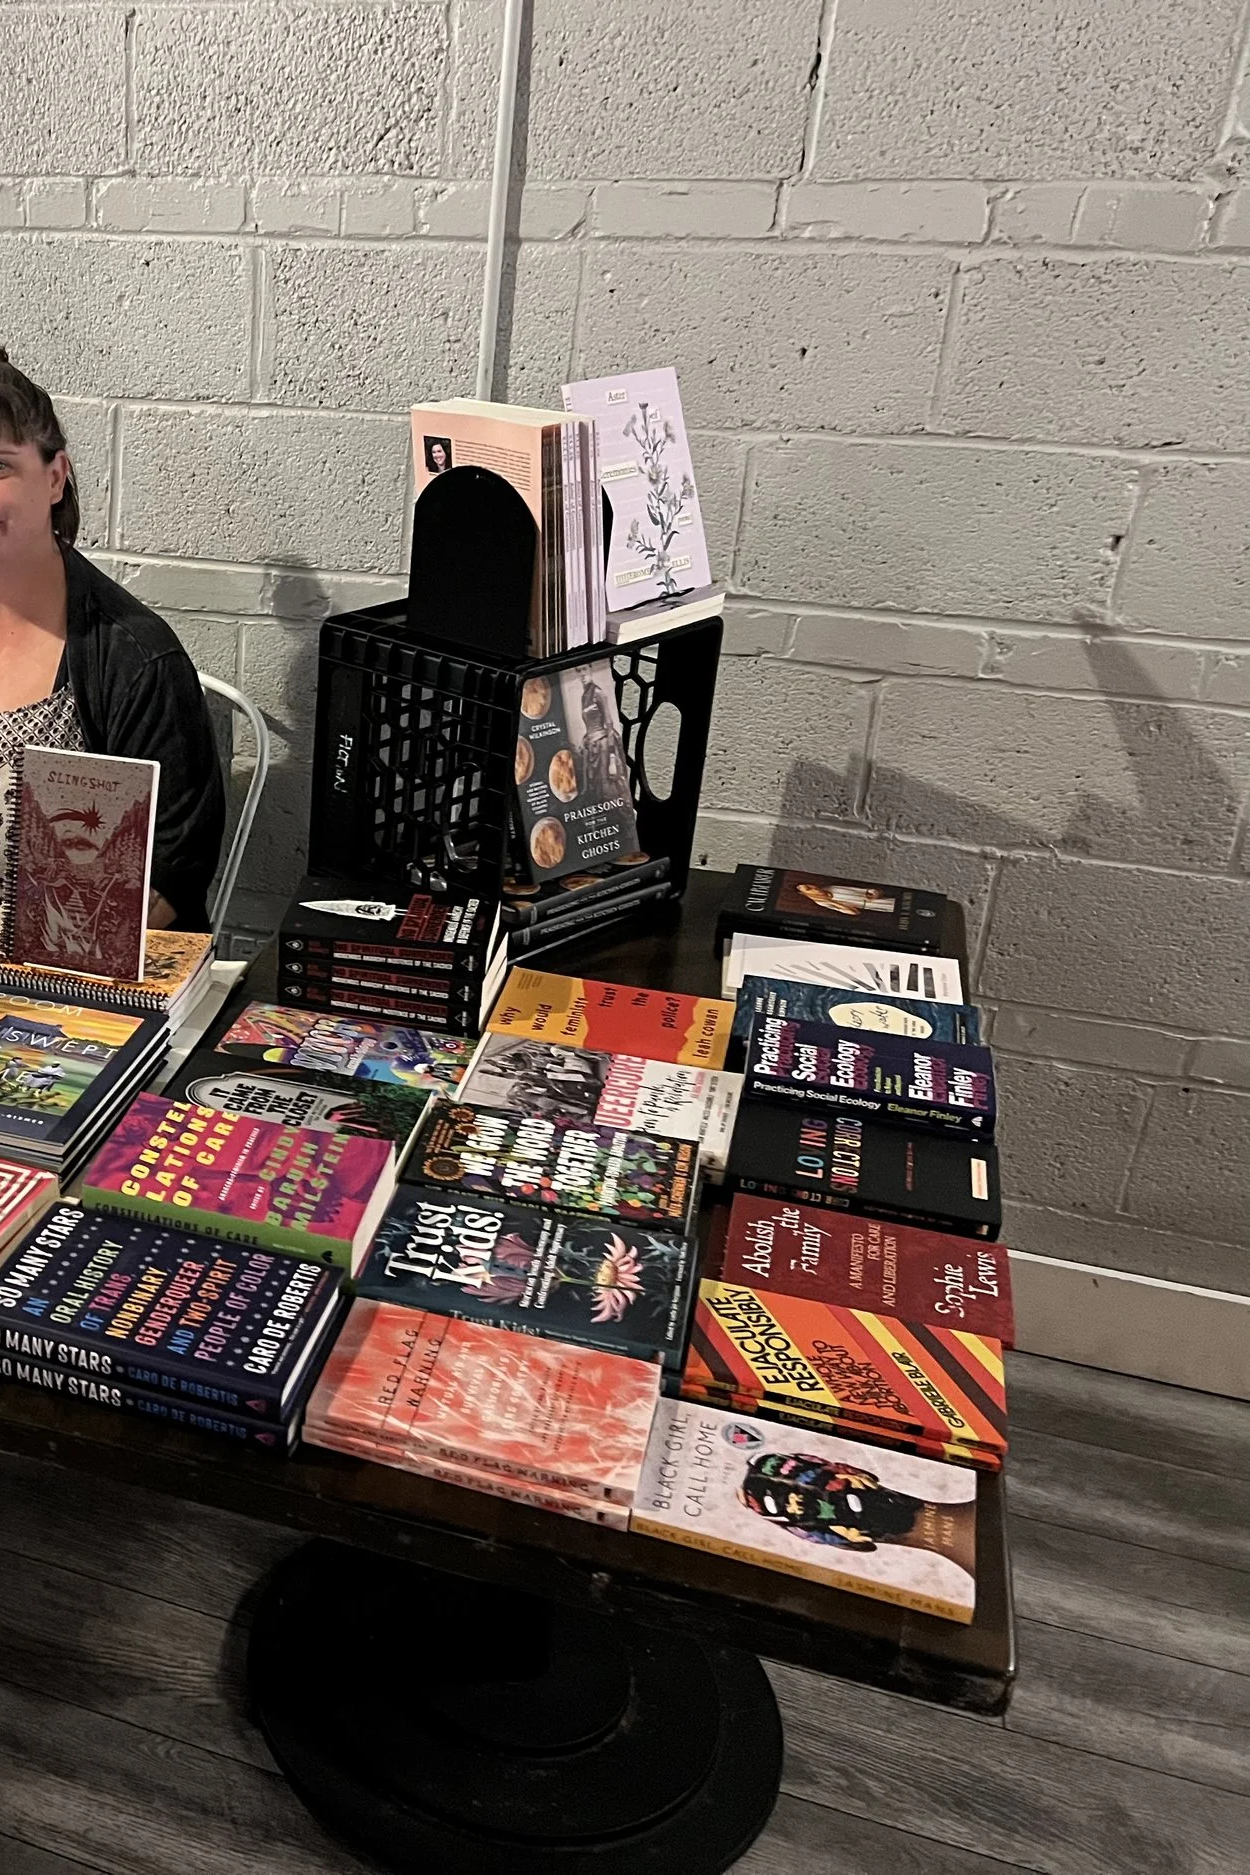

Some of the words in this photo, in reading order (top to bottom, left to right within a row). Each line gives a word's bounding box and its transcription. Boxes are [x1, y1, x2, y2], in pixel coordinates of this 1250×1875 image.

[529, 727, 561, 741] WILKINSON
[531, 721, 557, 732] CRYSTAL
[48, 771, 123, 792] SLINGSHOT
[564, 797, 624, 822] PRAISESONG
[577, 825, 620, 845] KITCHEN
[581, 840, 620, 860] GHOSTS
[500, 1006, 522, 1026] why
[532, 1003, 553, 1032] would
[561, 996, 589, 1038] feminists
[599, 986, 618, 1009] trust
[631, 992, 650, 1007] the
[661, 996, 682, 1030] police?
[7, 1030, 119, 1058] SWEPT
[693, 1037, 711, 1060] leah
[703, 1008, 720, 1038] cowan
[754, 1016, 788, 1076] Practicing
[792, 1042, 819, 1082] Social
[830, 1039, 861, 1089] Ecology
[593, 1054, 648, 1127] UEERCORE
[753, 1081, 807, 1099] Practicing
[806, 1089, 839, 1104] Social
[839, 1095, 881, 1111] Ecology
[908, 1052, 933, 1101] Eleanor
[948, 1067, 978, 1108] Finley
[210, 1088, 230, 1098] IT
[223, 1083, 256, 1112] CAME
[245, 1088, 273, 1115] FROM
[267, 1094, 293, 1115] THE
[282, 1092, 318, 1126] CLOSET
[886, 1102, 928, 1119] Eleanor
[928, 1109, 963, 1125] Finley
[121, 1101, 193, 1196] CONSTEL
[146, 1105, 216, 1202] LATIONS
[260, 1125, 298, 1181] CINDY
[466, 1114, 509, 1151] GROW
[509, 1118, 555, 1161] WORLD
[173, 1174, 200, 1207] OF
[196, 1111, 240, 1166] CARE
[460, 1152, 497, 1176] WE
[501, 1160, 544, 1188] THE
[550, 1129, 601, 1191] TOGETHER
[293, 1134, 350, 1231] MILSTEIN
[95, 1202, 201, 1236] CONSTELLATIONS
[205, 1225, 221, 1237] OF
[225, 1230, 259, 1245] CARE
[385, 1200, 458, 1279] Trust
[431, 1204, 505, 1290] Kids!
[742, 1219, 776, 1279] Abolish
[772, 1206, 801, 1236] the
[790, 1222, 832, 1276] Family
[868, 1222, 882, 1245] CARE
[9, 1245, 54, 1288] MANY
[34, 1207, 85, 1249] STARS
[849, 1232, 864, 1281] MANIFESTO
[867, 1244, 880, 1262] FOR
[883, 1235, 898, 1290] LIBERATION
[22, 1297, 50, 1317] AN
[50, 1291, 89, 1324] ORAL
[73, 1240, 124, 1292] HISTORY
[178, 1258, 238, 1328] TWO-SPIRIT
[235, 1253, 276, 1292] COLOR
[273, 1263, 322, 1320] ROBERTIS
[849, 1280, 863, 1290] A
[934, 1262, 966, 1318] Sophie
[966, 1251, 1000, 1301] Lewis
[225, 1292, 250, 1310] OF
[881, 1289, 895, 1308] AND
[80, 1313, 104, 1331] OF
[167, 1329, 195, 1355] AND
[194, 1311, 241, 1362] PEOPLE
[262, 1319, 291, 1339] DE
[706, 1296, 787, 1386] EJACULATE
[724, 1287, 826, 1393] RESPONSIBLY
[5, 1330, 54, 1359] MANY
[57, 1342, 113, 1376] STARS
[127, 1366, 160, 1385] CARO
[161, 1375, 177, 1391] DE
[180, 1379, 239, 1407] ROBERTIS
[243, 1338, 281, 1375] CARO
[401, 1327, 420, 1368] FLAG
[812, 1340, 831, 1354] TO
[821, 1356, 852, 1380] WAY
[891, 1351, 924, 1380] BLAIR
[16, 1362, 64, 1391] MANY
[67, 1376, 122, 1408] STARS
[378, 1373, 401, 1407] RED
[406, 1336, 443, 1408] WARNING
[806, 1355, 847, 1393] WHOLE
[785, 1395, 841, 1417] EJACULATE
[665, 1412, 693, 1453] GIRL,
[694, 1422, 718, 1474] HOME
[439, 1447, 470, 1463] RED
[474, 1456, 515, 1475] FLAG
[518, 1465, 591, 1493] WARNING
[652, 1458, 680, 1511] BLACK
[683, 1473, 708, 1518] CALL
